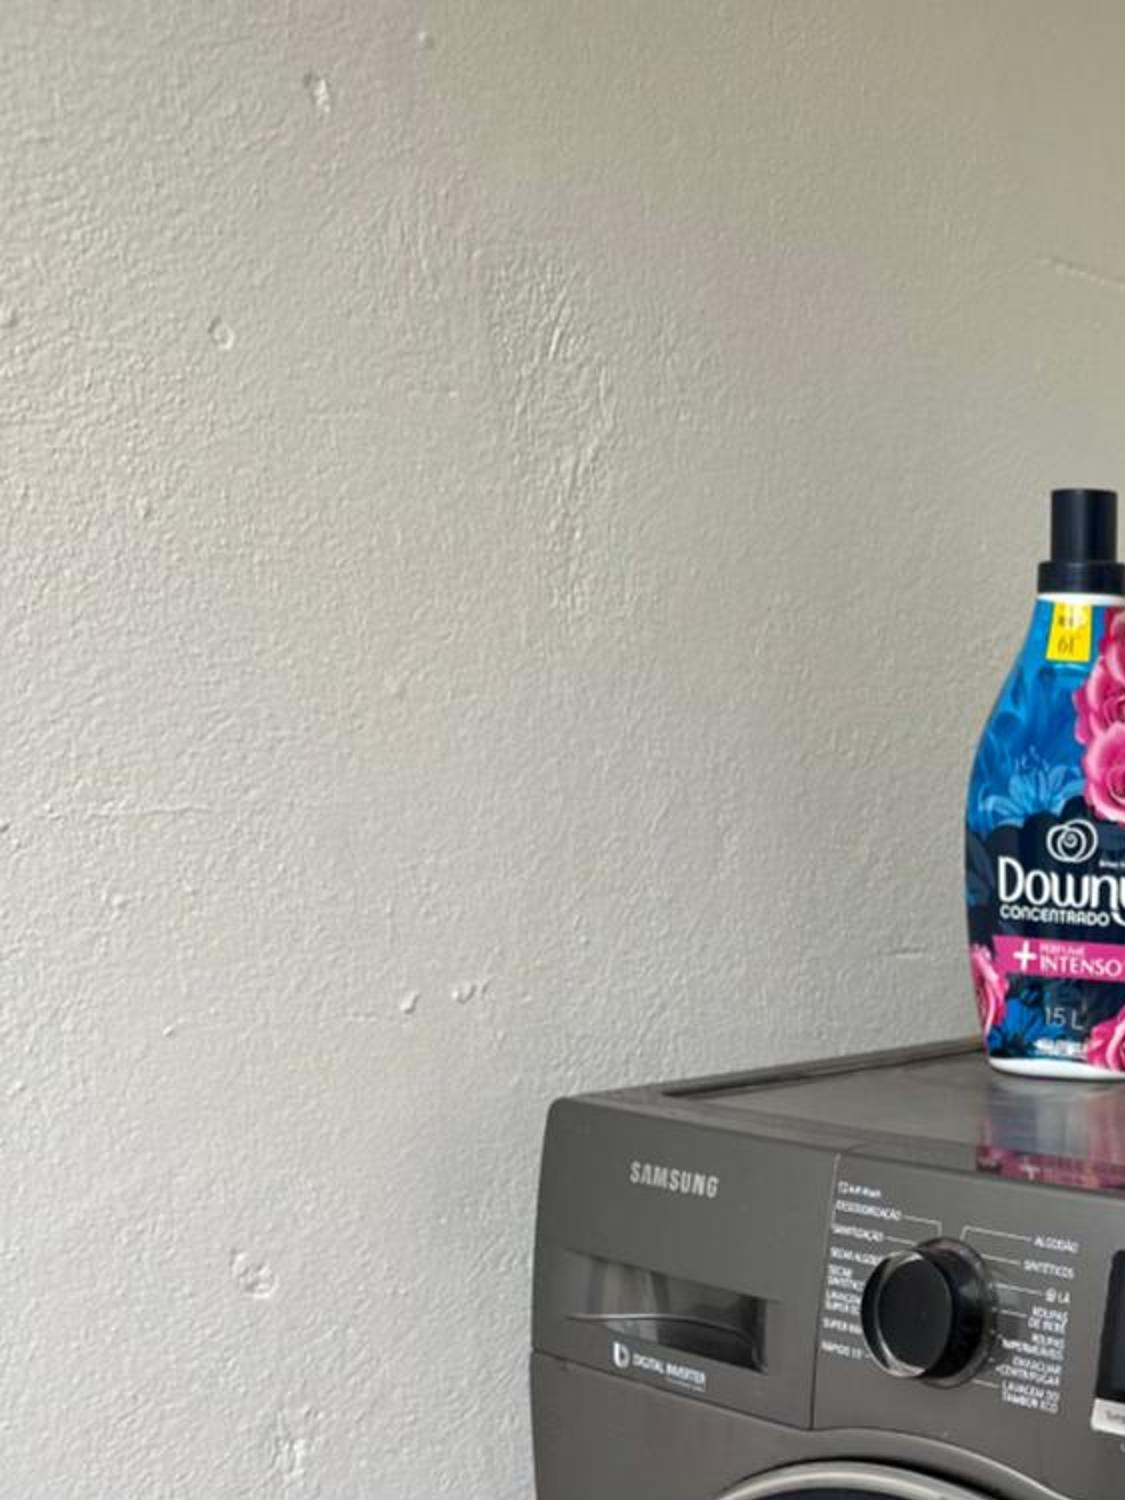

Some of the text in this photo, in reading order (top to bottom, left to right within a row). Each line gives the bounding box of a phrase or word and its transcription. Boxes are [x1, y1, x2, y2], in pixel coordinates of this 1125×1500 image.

[1000, 905, 1110, 927] CONCENTRADO
[1040, 956, 1123, 977] INTENSO
[630, 1161, 719, 1198] SAMSUNG
